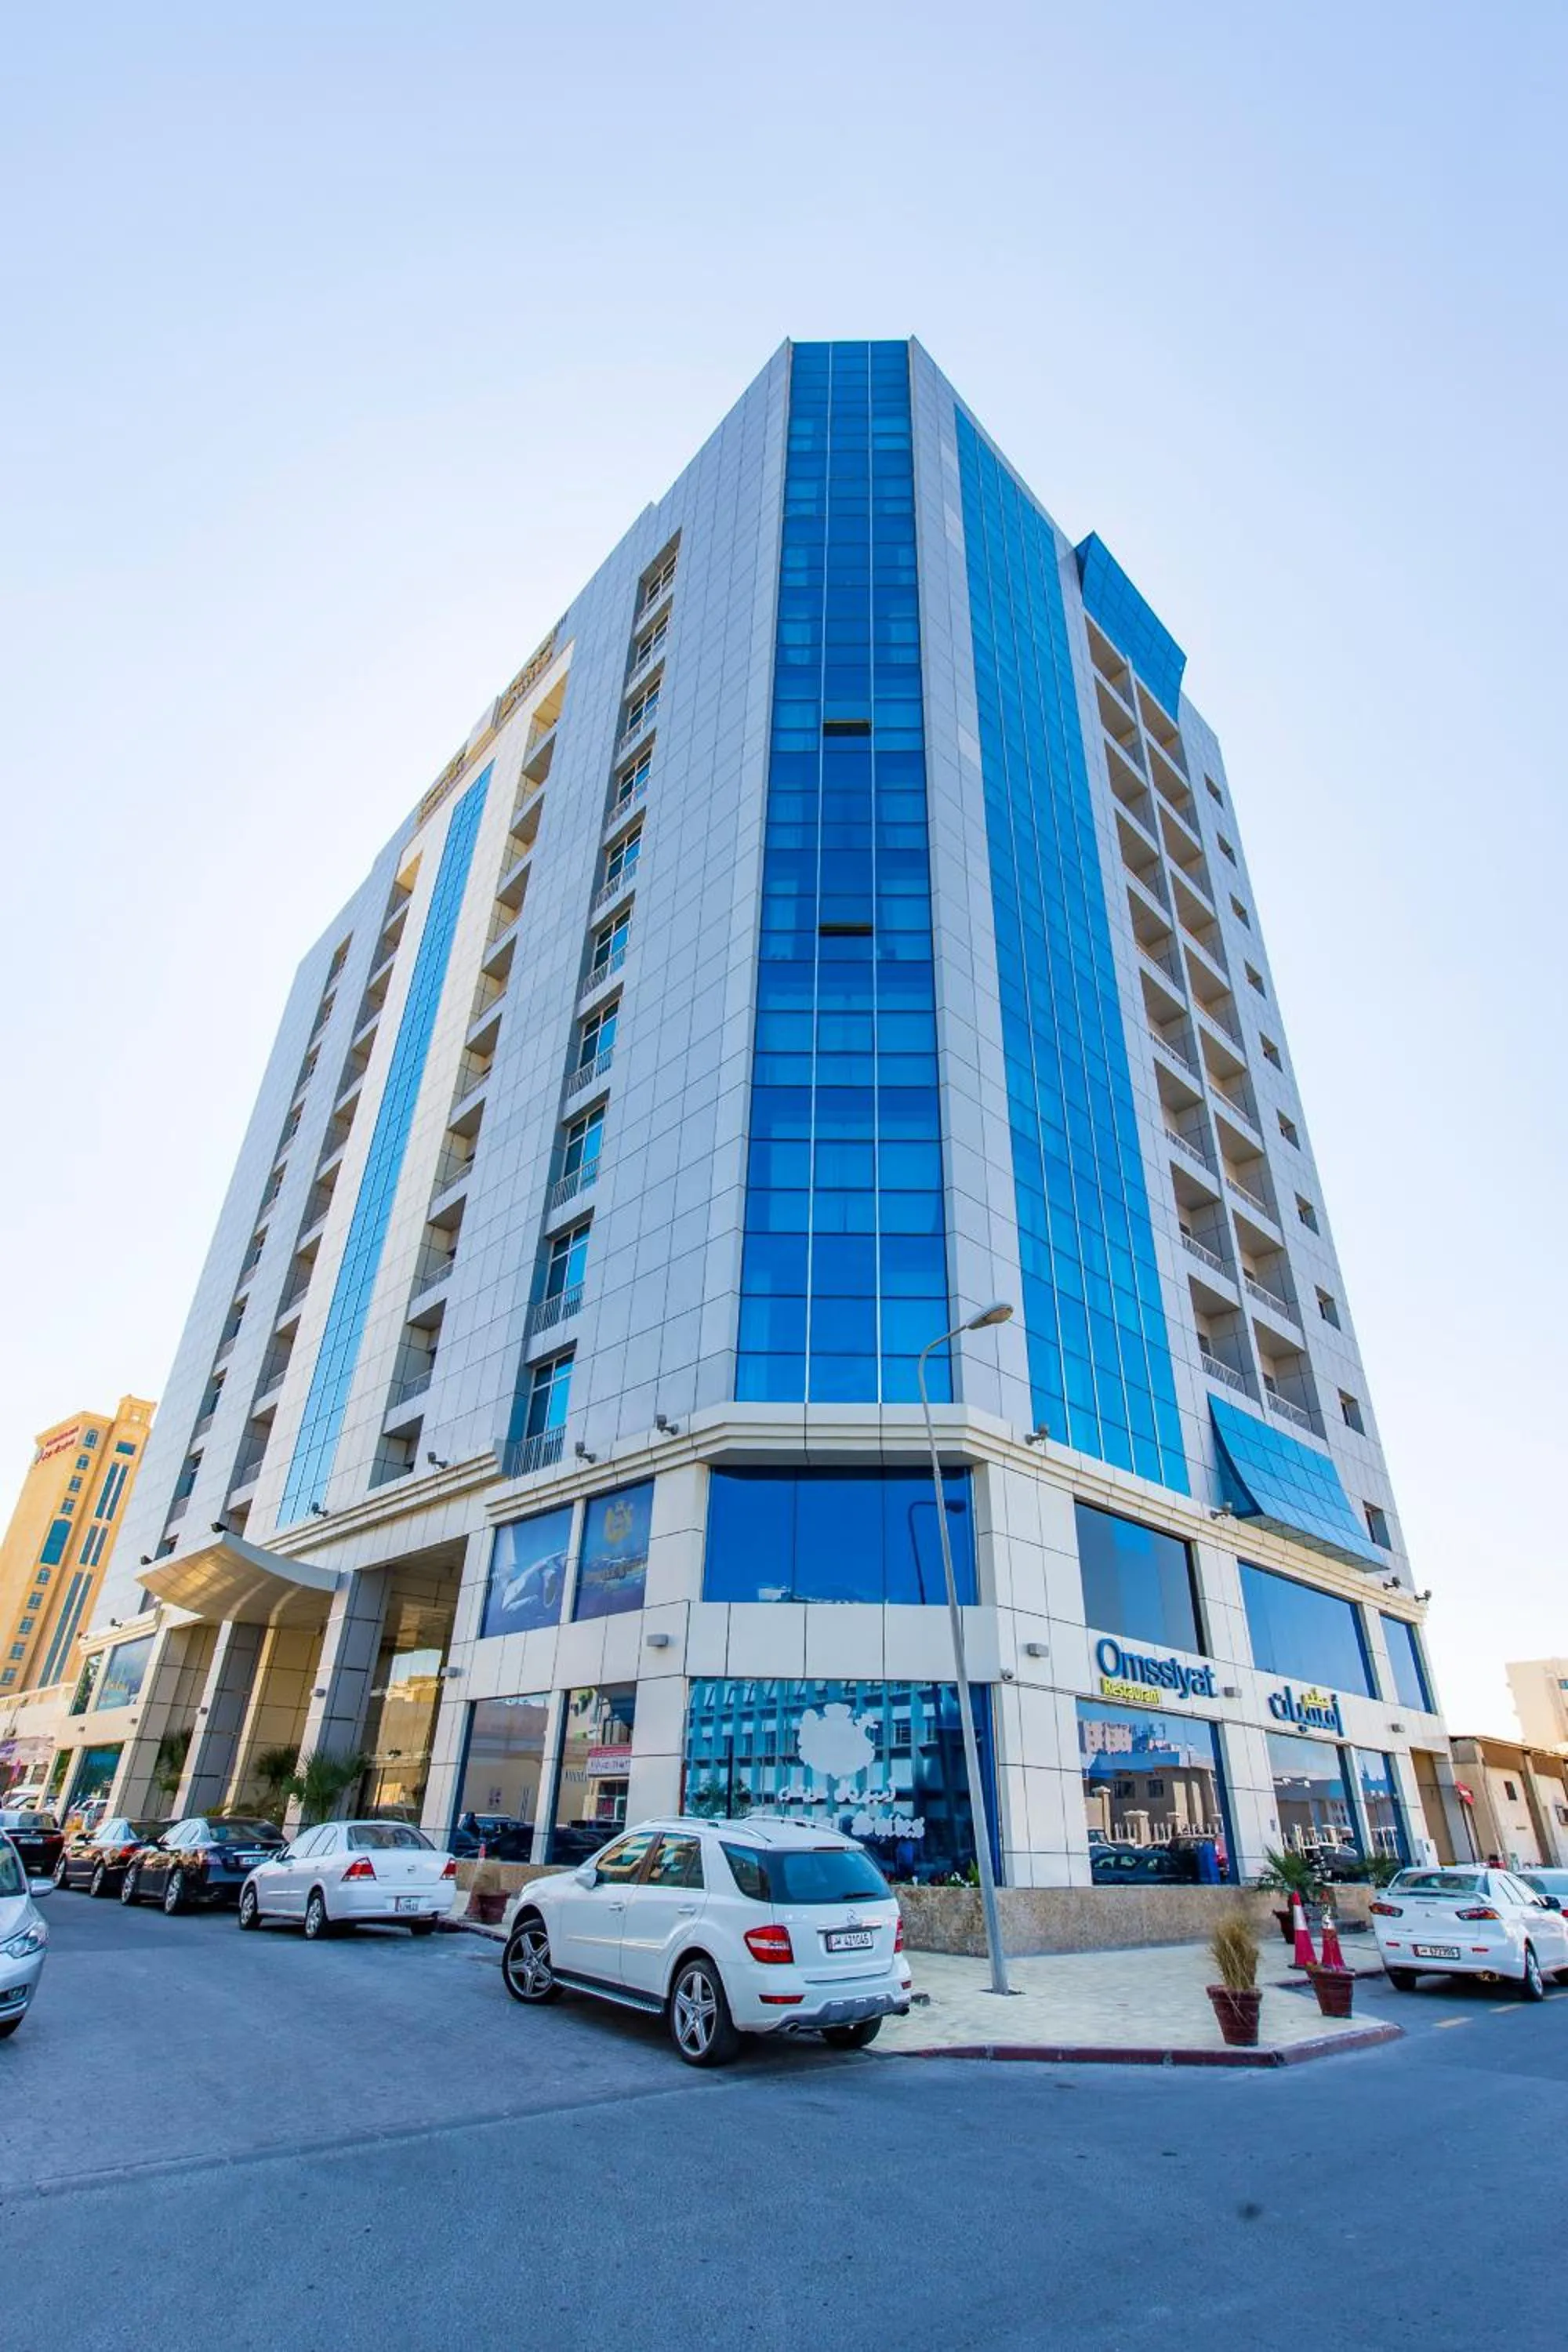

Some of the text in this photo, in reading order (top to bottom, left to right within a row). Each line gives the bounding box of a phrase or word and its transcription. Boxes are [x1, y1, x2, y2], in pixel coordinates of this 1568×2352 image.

[1096, 1638, 1218, 1699] Omssiyat
[1100, 1676, 1160, 1705] Restaurant
[1268, 1685, 1345, 1738] أمسيات
